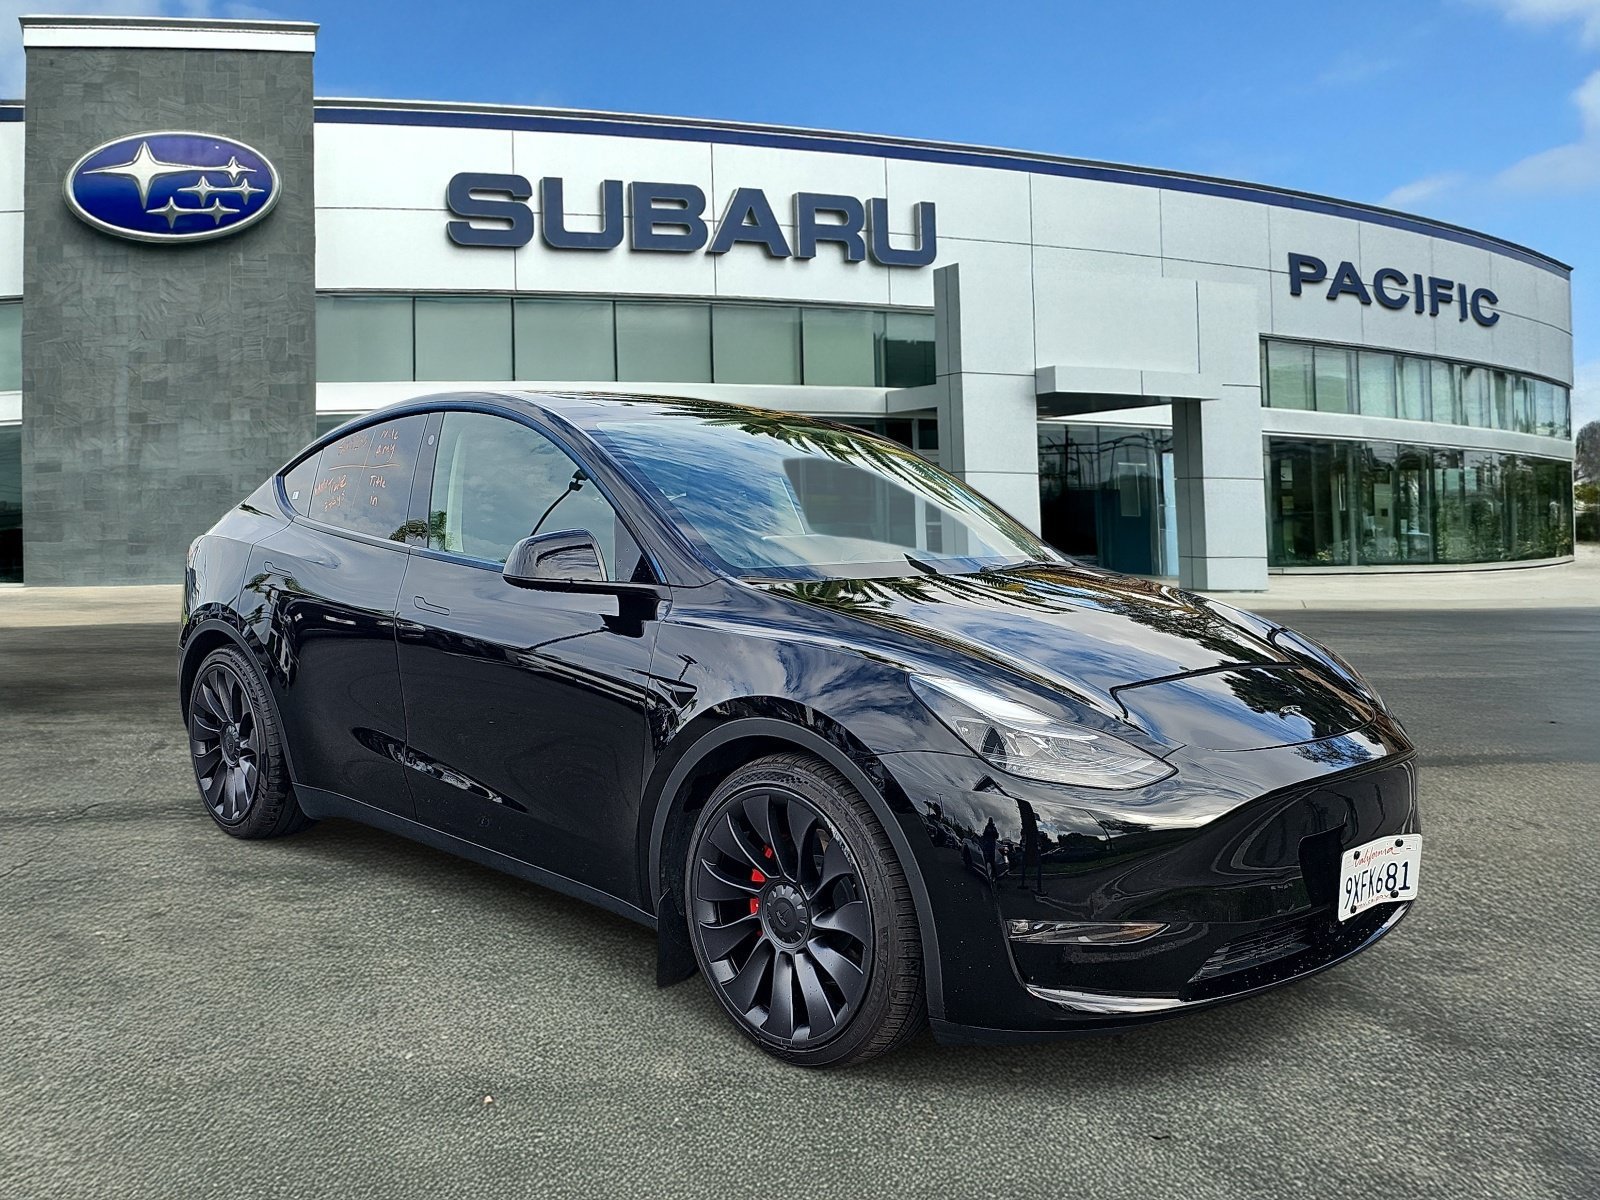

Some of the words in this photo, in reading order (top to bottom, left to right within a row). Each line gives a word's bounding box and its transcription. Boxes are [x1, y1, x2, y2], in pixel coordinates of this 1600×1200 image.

[447, 172, 937, 268] SUBARU
[1288, 252, 1500, 327] PACIFIC
[1344, 861, 1411, 910] 9XFK681
